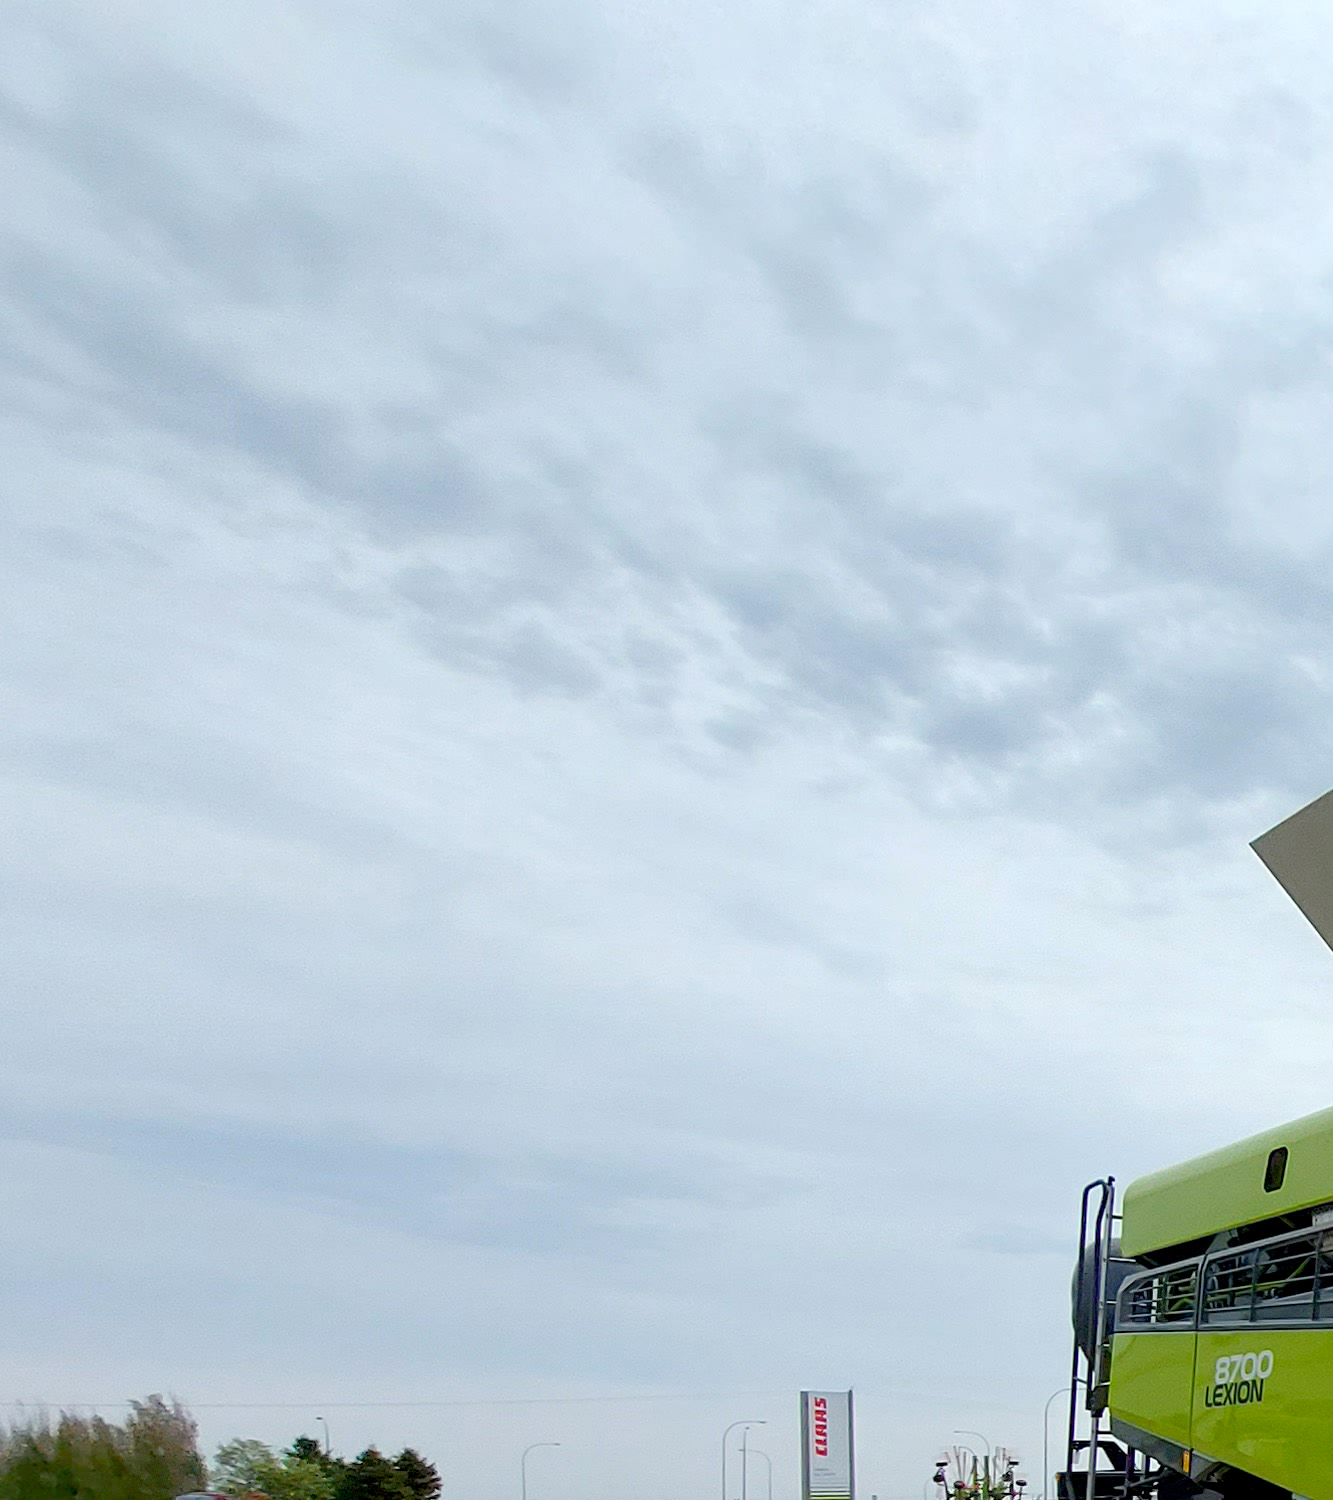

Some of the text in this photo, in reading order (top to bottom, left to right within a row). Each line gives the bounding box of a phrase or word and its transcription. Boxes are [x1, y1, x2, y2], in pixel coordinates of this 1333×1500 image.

[1214, 1350, 1274, 1386] 8700
[1205, 1379, 1264, 1408] LEXION
[814, 1397, 828, 1457] CLAAS
